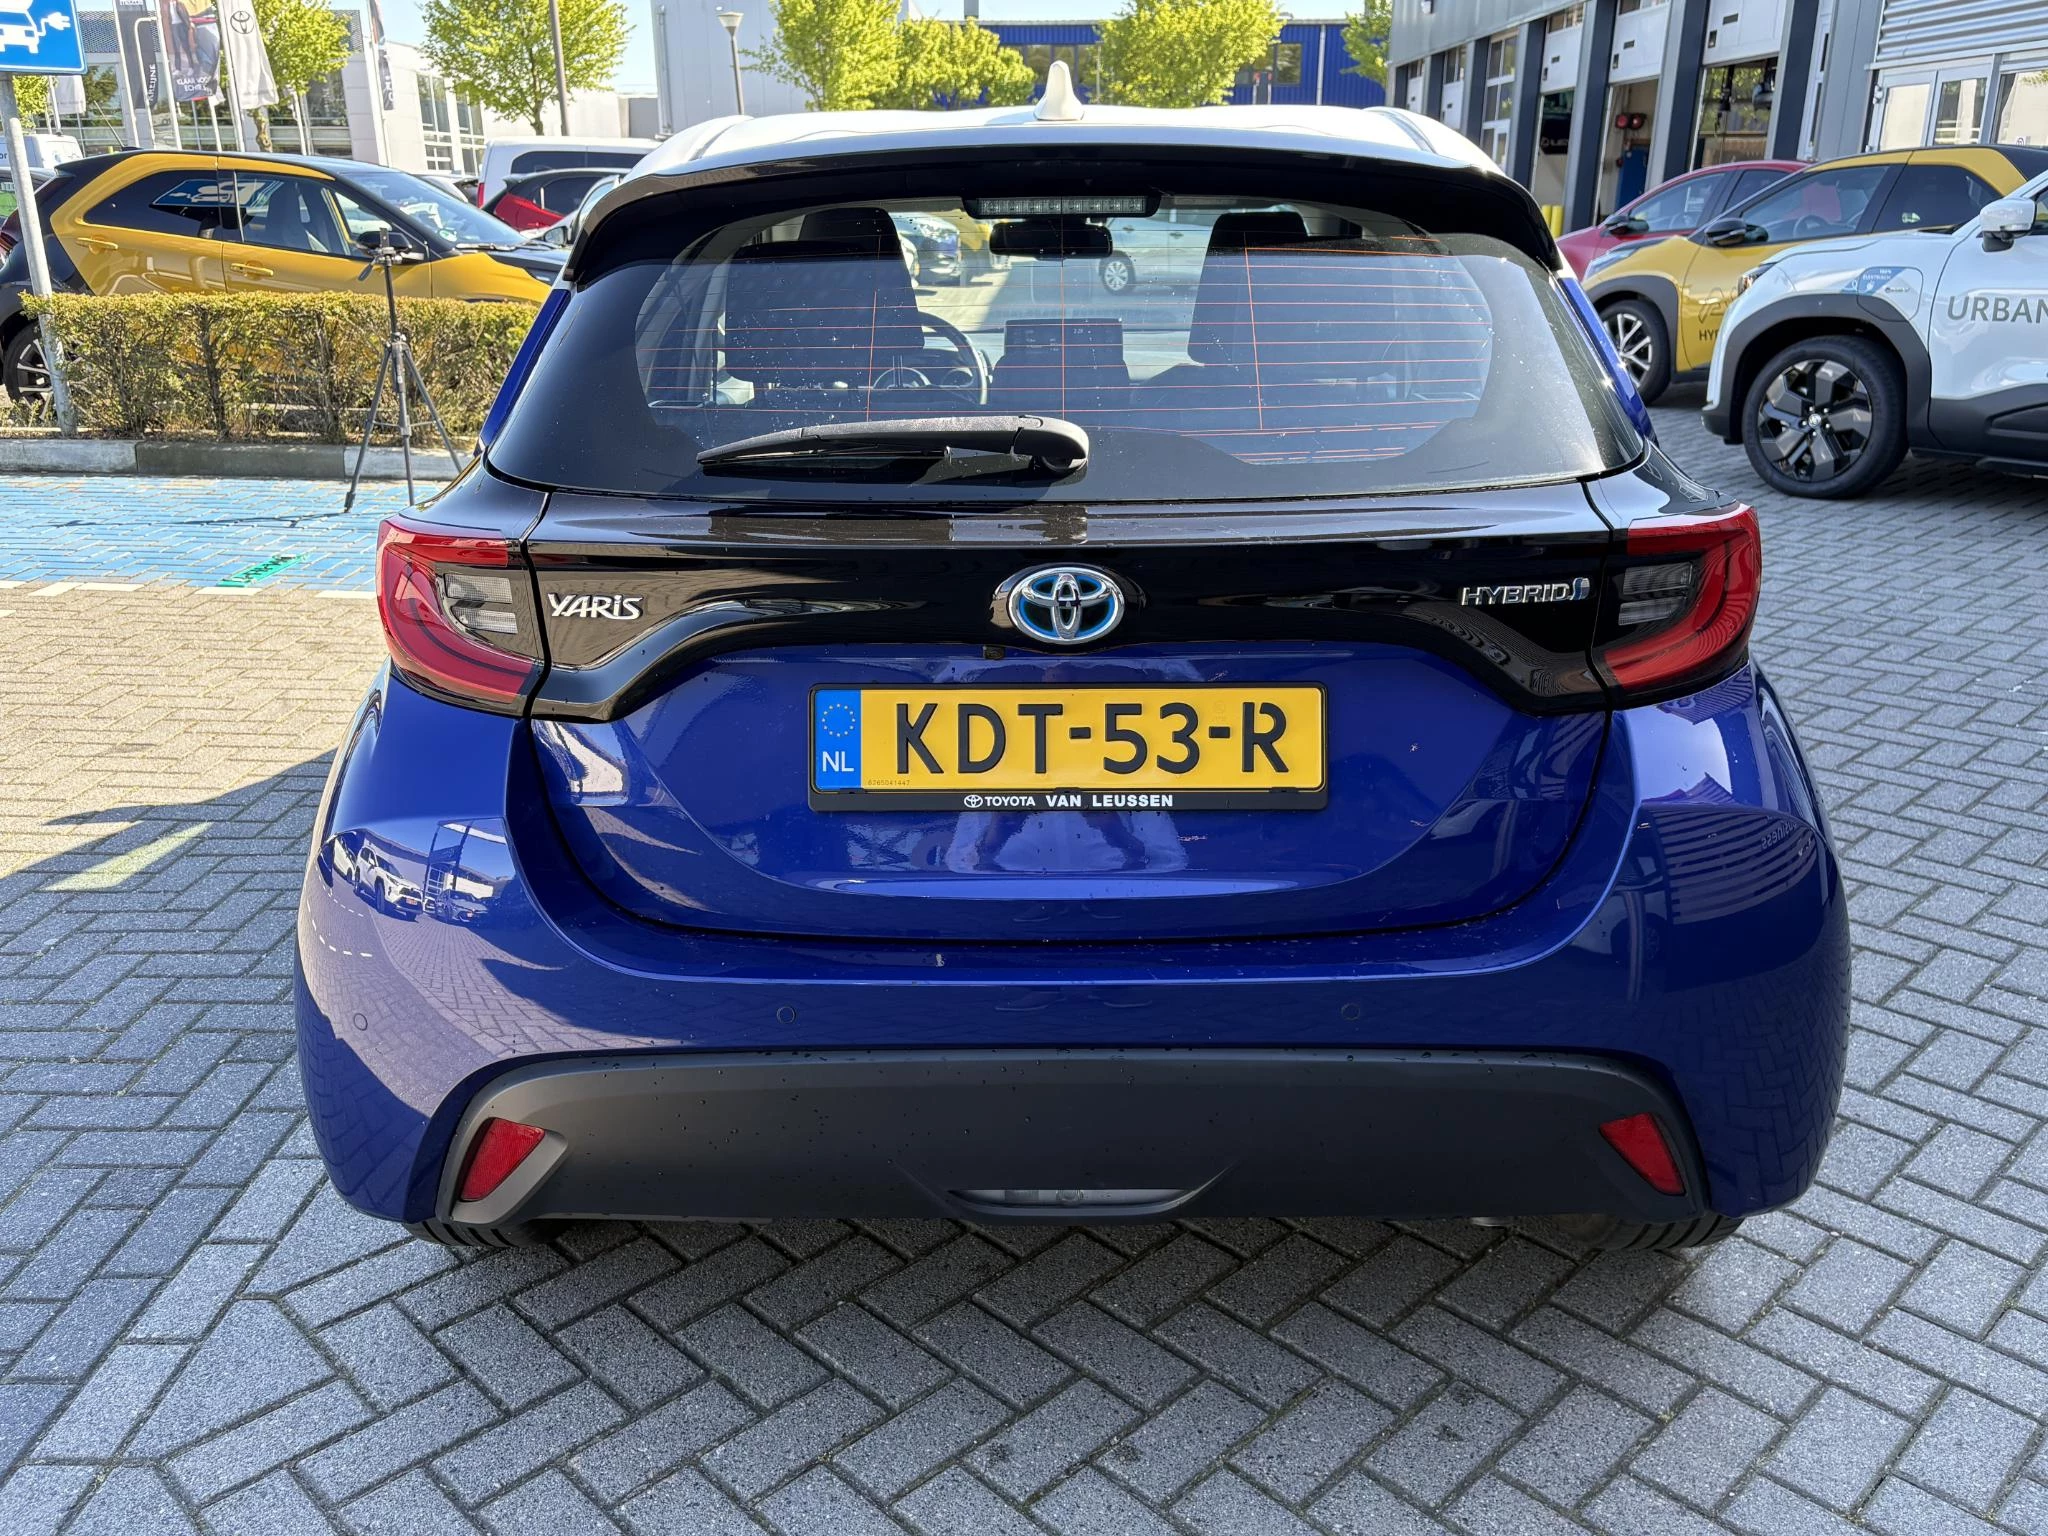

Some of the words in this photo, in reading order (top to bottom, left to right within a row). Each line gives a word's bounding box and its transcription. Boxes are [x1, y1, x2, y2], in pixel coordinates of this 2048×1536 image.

[1461, 583, 1570, 606] HYBRID
[896, 702, 1289, 774] KDT-53-R
[821, 751, 855, 773] NL
[984, 796, 1036, 807] TOYOTA
[1045, 795, 1082, 807] VAN
[1092, 795, 1173, 807] LEUSSEN
